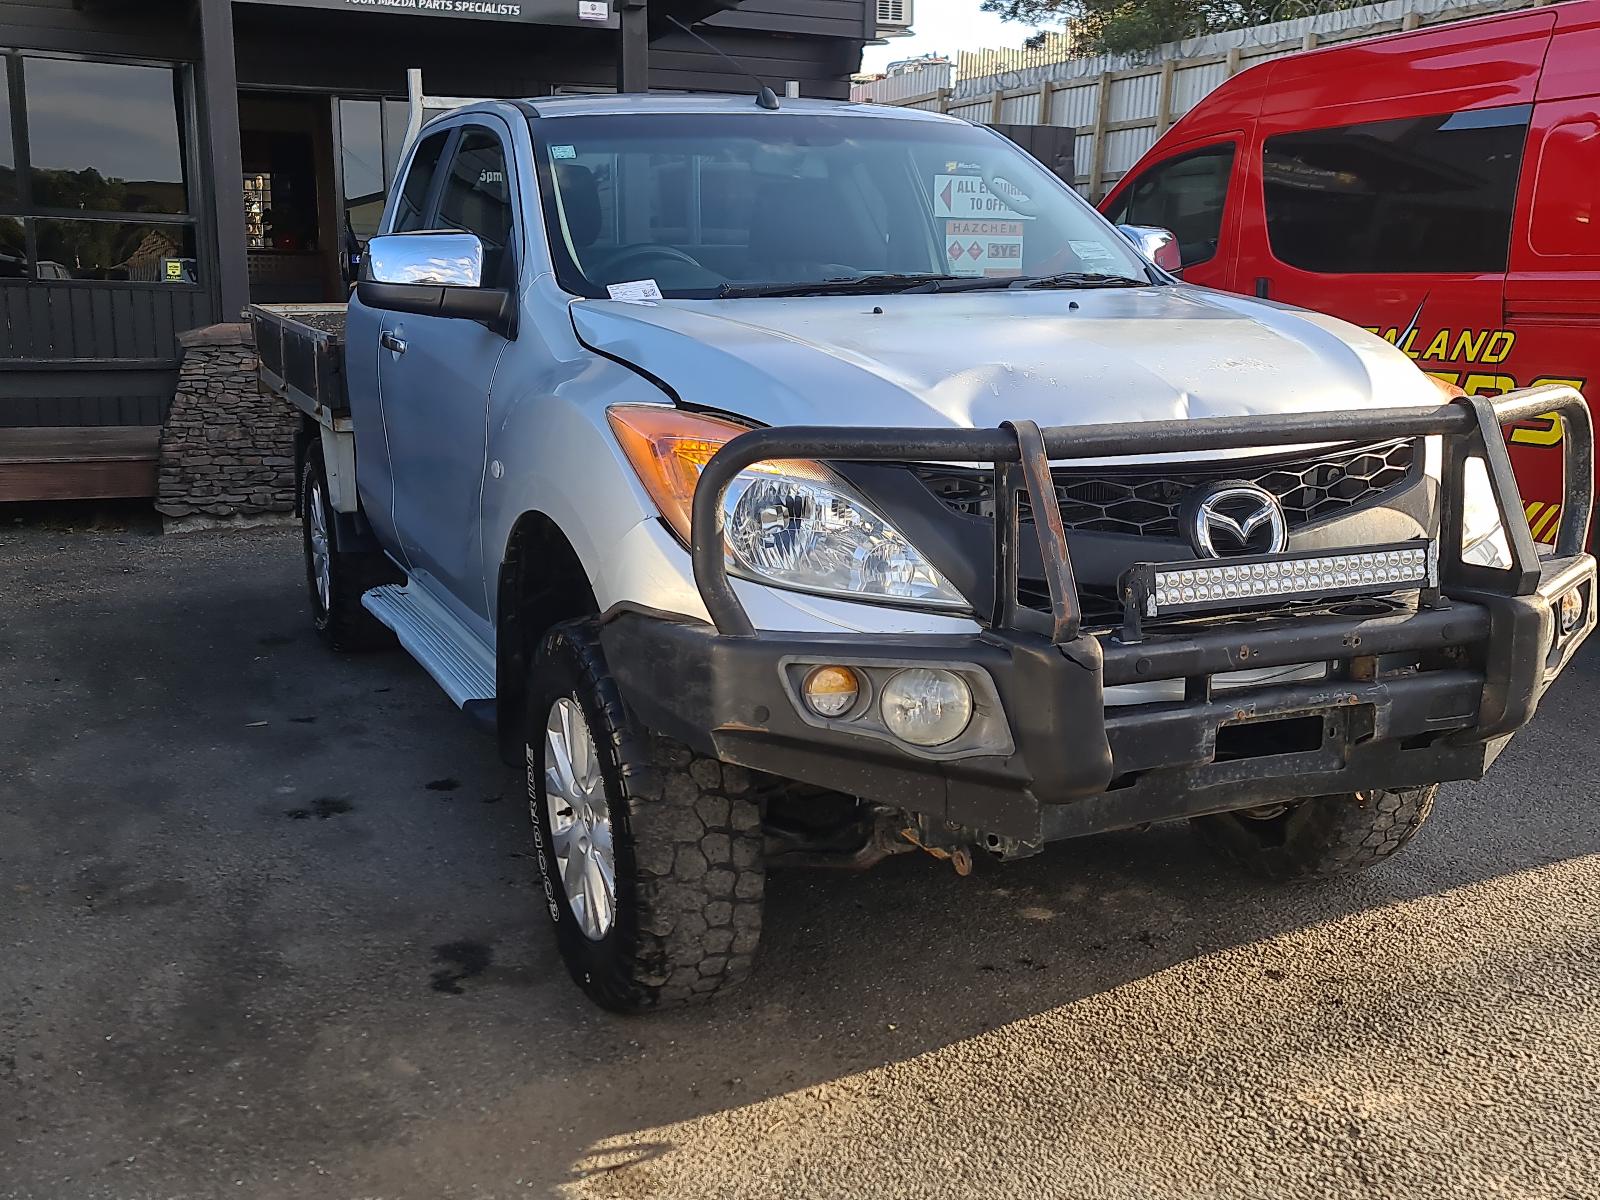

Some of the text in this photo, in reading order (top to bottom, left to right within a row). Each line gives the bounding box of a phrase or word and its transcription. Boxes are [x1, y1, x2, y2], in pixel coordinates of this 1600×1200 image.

[418, 0, 453, 11] PARTS
[454, 1, 520, 15] SPECIALISTS
[957, 180, 976, 193] ALL
[970, 197, 1009, 211] TO OFFI
[953, 223, 1017, 233] HAZCHEM
[991, 244, 1017, 257] 3YE
[525, 742, 560, 922] GOODRIDE
